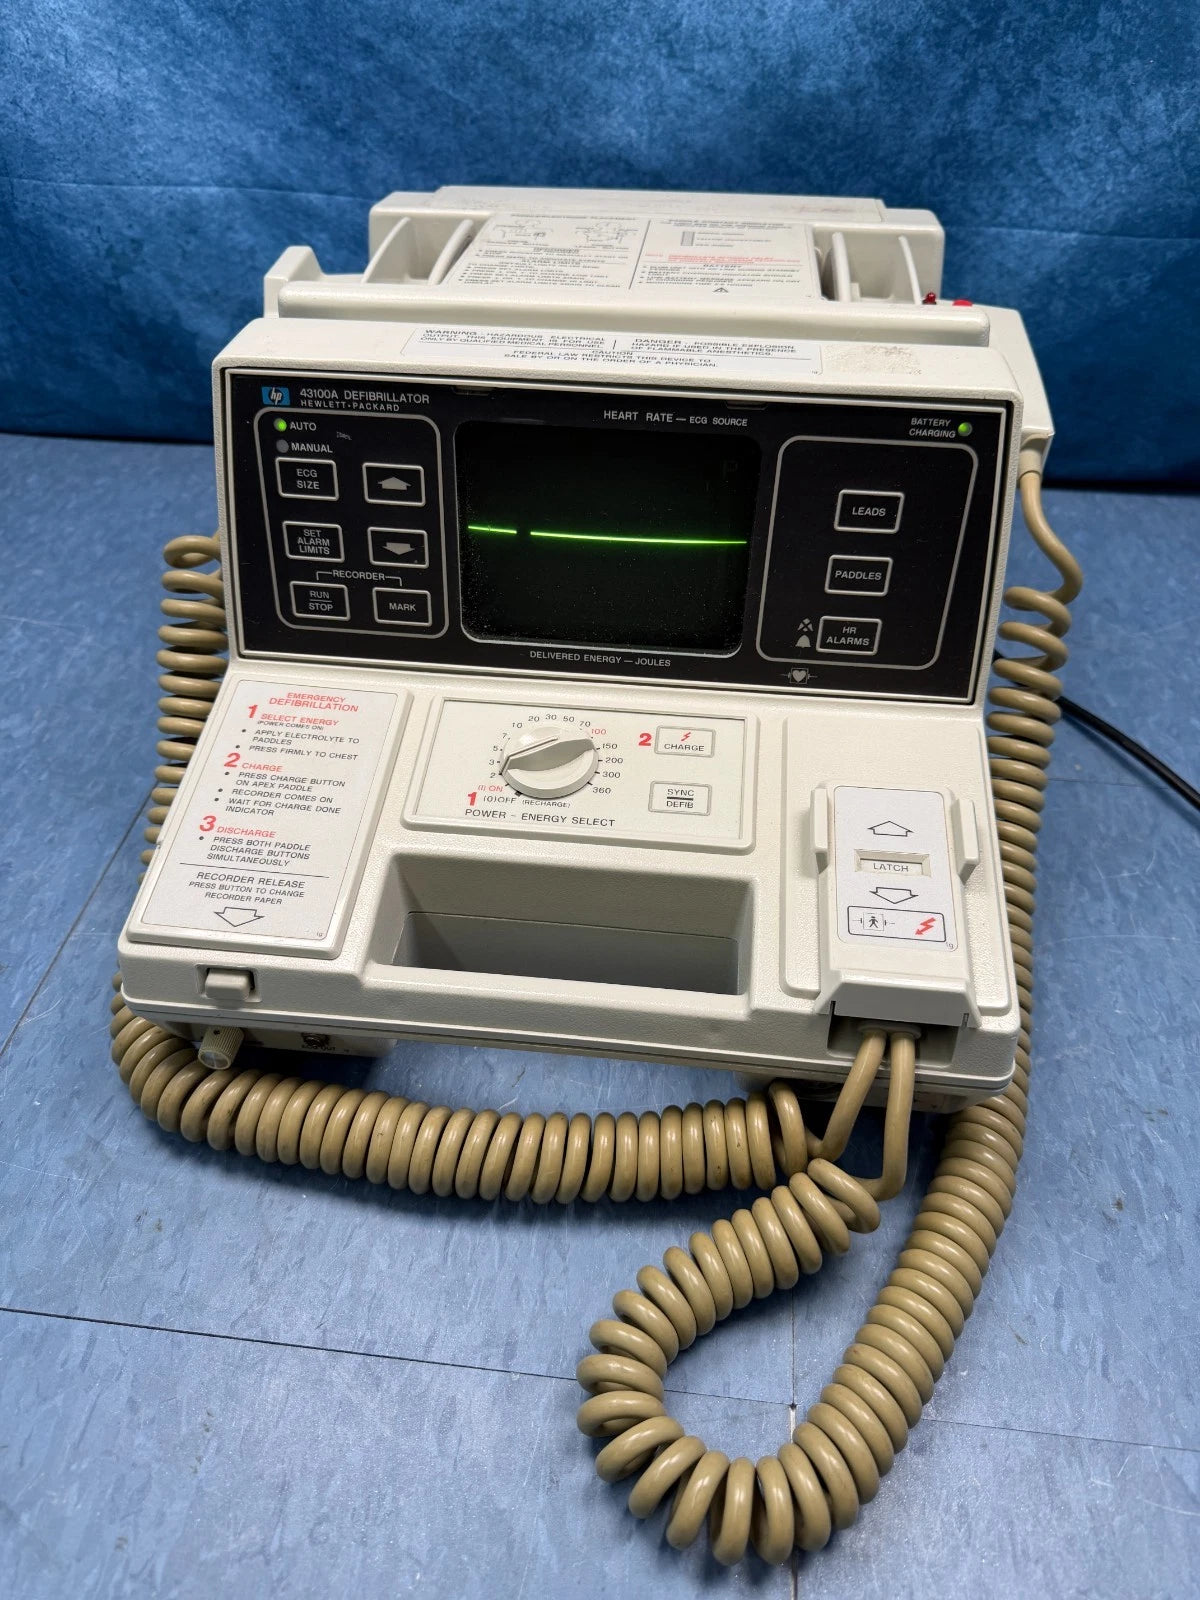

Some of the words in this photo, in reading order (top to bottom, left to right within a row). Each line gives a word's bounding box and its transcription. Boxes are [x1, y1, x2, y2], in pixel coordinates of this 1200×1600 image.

[270, 389, 282, 404] hp
[300, 388, 339, 400] 43100A
[344, 391, 430, 404] DEFIBRILLATOR
[604, 410, 638, 422] HEART
[646, 412, 673, 423] RATE
[690, 416, 707, 425] ECG
[713, 417, 748, 427] SOURCE
[911, 417, 951, 428] BATTERY
[290, 421, 317, 431] AUTO
[909, 427, 956, 439] CHARGING
[291, 442, 333, 453] MANUAL
[296, 468, 318, 478] ECG
[296, 480, 320, 490] SIZE
[852, 506, 886, 517] LEADS
[303, 529, 320, 538] SET
[297, 537, 330, 546] ALARM
[299, 545, 330, 555] LIMITS
[332, 569, 386, 581] RECORDER
[835, 570, 882, 581] PADDLES
[310, 590, 330, 599] RUN
[308, 602, 333, 611] STOP
[389, 603, 416, 612] MARK
[842, 626, 857, 635] HR
[826, 635, 870, 646] ALARMS
[530, 651, 580, 661] DELIVERED
[584, 654, 621, 664] ENERGY
[635, 658, 671, 667] JOULES
[287, 692, 346, 703] EMERGENCY
[269, 698, 359, 712] DEFIBRILLATION
[248, 704, 258, 719] 1
[261, 713, 297, 723] SELECT
[300, 717, 340, 726] ENERGY
[252, 737, 292, 746] PADDLES
[255, 729, 282, 738] APPLY
[285, 732, 344, 743] ELECTROLYTE
[639, 733, 652, 746] 2
[249, 745, 277, 753] PRESS
[280, 748, 312, 756] FIRMLY
[329, 752, 359, 761] CHEST
[664, 743, 705, 752] CHARGE
[224, 753, 241, 768] 2
[242, 762, 283, 773] CHARGE
[238, 772, 267, 781] PRESS
[270, 774, 308, 784] CHARGE
[311, 778, 346, 787] BUTTON
[252, 781, 275, 789] APEX
[278, 784, 313, 792] PADDLE
[232, 789, 282, 799] RECORDER
[284, 793, 317, 802] COMES
[468, 792, 477, 806] 1
[229, 798, 250, 806] WAIT
[254, 799, 271, 808] FOR
[274, 802, 312, 812] CHARGE
[315, 806, 341, 814] DONE
[522, 799, 571, 808] (RECHARGE)
[666, 801, 694, 809] DEFIB
[225, 806, 275, 816] INDICATOR
[199, 815, 217, 832] 3
[465, 808, 507, 819] POWER
[521, 813, 567, 823] ENERGY
[571, 816, 616, 827] SELECT
[217, 826, 276, 838] DISCHARGE
[213, 836, 244, 845] PRESS
[246, 839, 272, 848] BOTH
[274, 841, 311, 851] PADDLE
[210, 845, 264, 856] DISCHARGE
[267, 850, 310, 860] BUTTONS
[206, 853, 290, 867] SIMULTANEOUSLY
[873, 863, 909, 872] LATCH
[196, 872, 254, 884] RECORDER
[258, 877, 306, 889] RELEASE
[219, 883, 252, 892] BUTTON
[269, 888, 305, 898] CHANGE
[204, 891, 252, 902] RECORDER
[254, 896, 282, 905] PAPER
